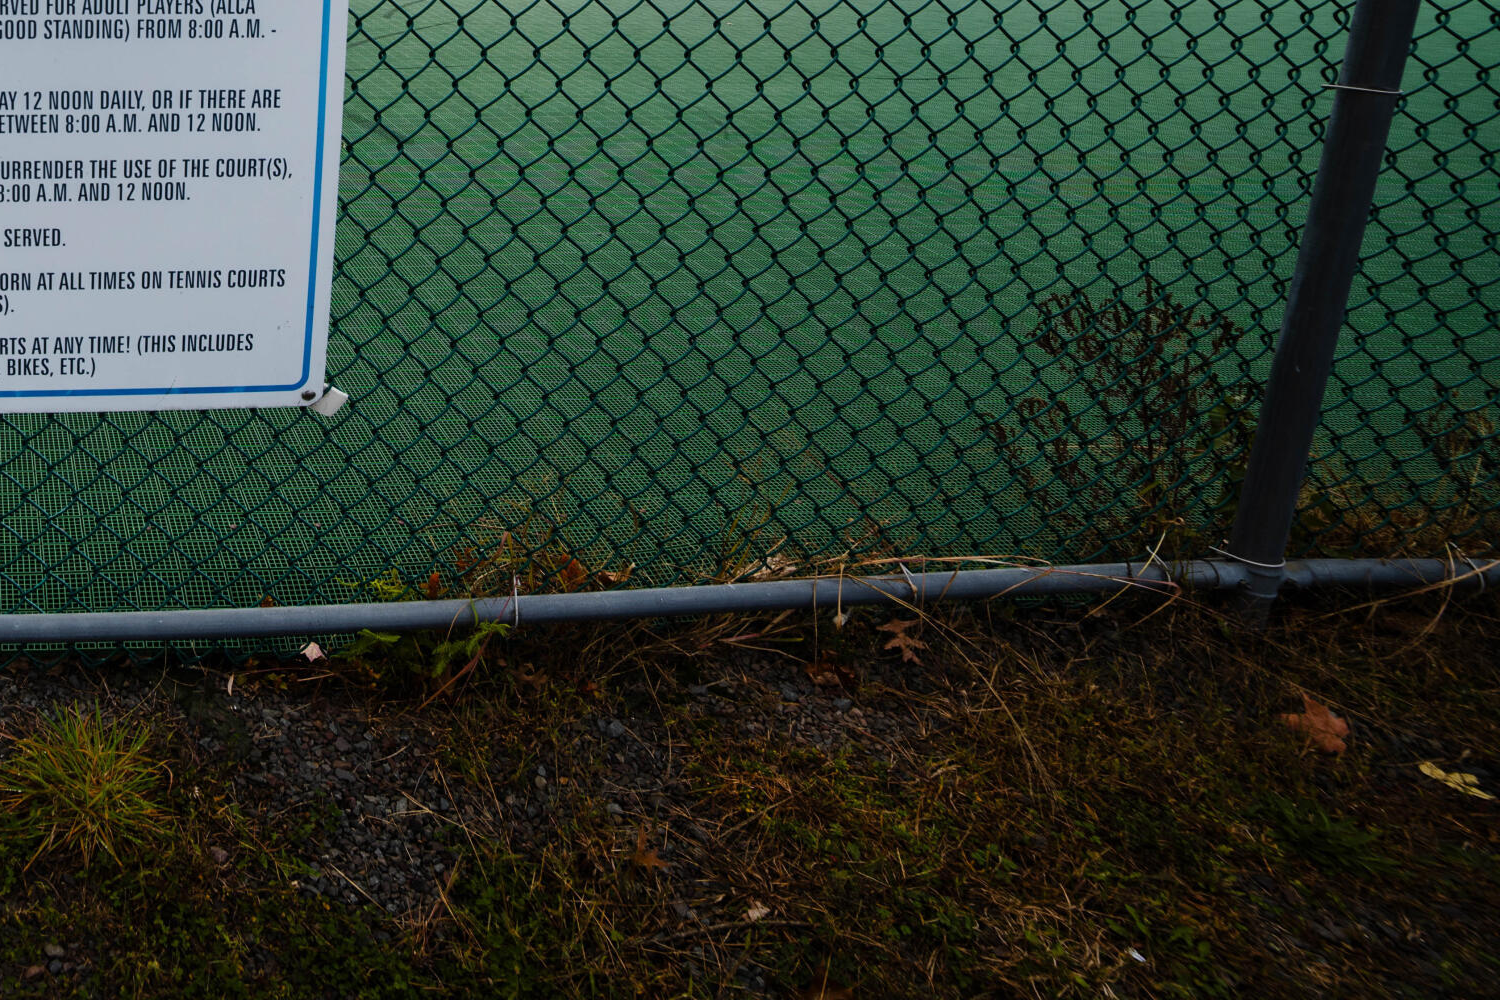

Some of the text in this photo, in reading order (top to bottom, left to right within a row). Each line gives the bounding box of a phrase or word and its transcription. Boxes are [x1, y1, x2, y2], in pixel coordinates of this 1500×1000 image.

[43, 18, 129, 42] STANDING)
[137, 18, 181, 38] FROM
[188, 19, 223, 38] 8:00
[228, 18, 264, 38] A.M.
[23, 91, 41, 110] 12
[49, 90, 93, 110] NOON
[100, 90, 145, 111] DAILY,
[152, 89, 172, 109] OR
[179, 89, 192, 109] IF
[198, 89, 245, 108] THERE
[251, 89, 280, 108] ARE
[65, 114, 99, 133] 8:00
[105, 113, 141, 132] A.M.
[147, 113, 180, 132] AND
[187, 113, 205, 132] 12
[212, 112, 260, 132] NOON.
[89, 159, 116, 178] THE
[123, 159, 151, 178] USE
[158, 159, 176, 178] OF
[182, 158, 209, 177] THE
[216, 157, 292, 180] COURT(S),
[36, 183, 71, 202] A.M.
[77, 182, 109, 201] AND
[117, 182, 135, 201] 12
[141, 181, 190, 201] NOON.
[3, 228, 65, 247] SERVED.
[36, 272, 54, 290] AT
[58, 272, 85, 290] ALL
[89, 271, 135, 289] TIMES
[141, 270, 162, 289] ON
[168, 270, 221, 288] TENNIS
[227, 268, 285, 288] COURTS
[31, 336, 49, 354] AT
[53, 336, 83, 354] ANY
[88, 335, 130, 353] TIME!
[137, 334, 175, 355] (THIS
[181, 333, 253, 352] INCLUDES
[7, 357, 53, 377] BIKES,
[60, 357, 95, 377] ETC.)
